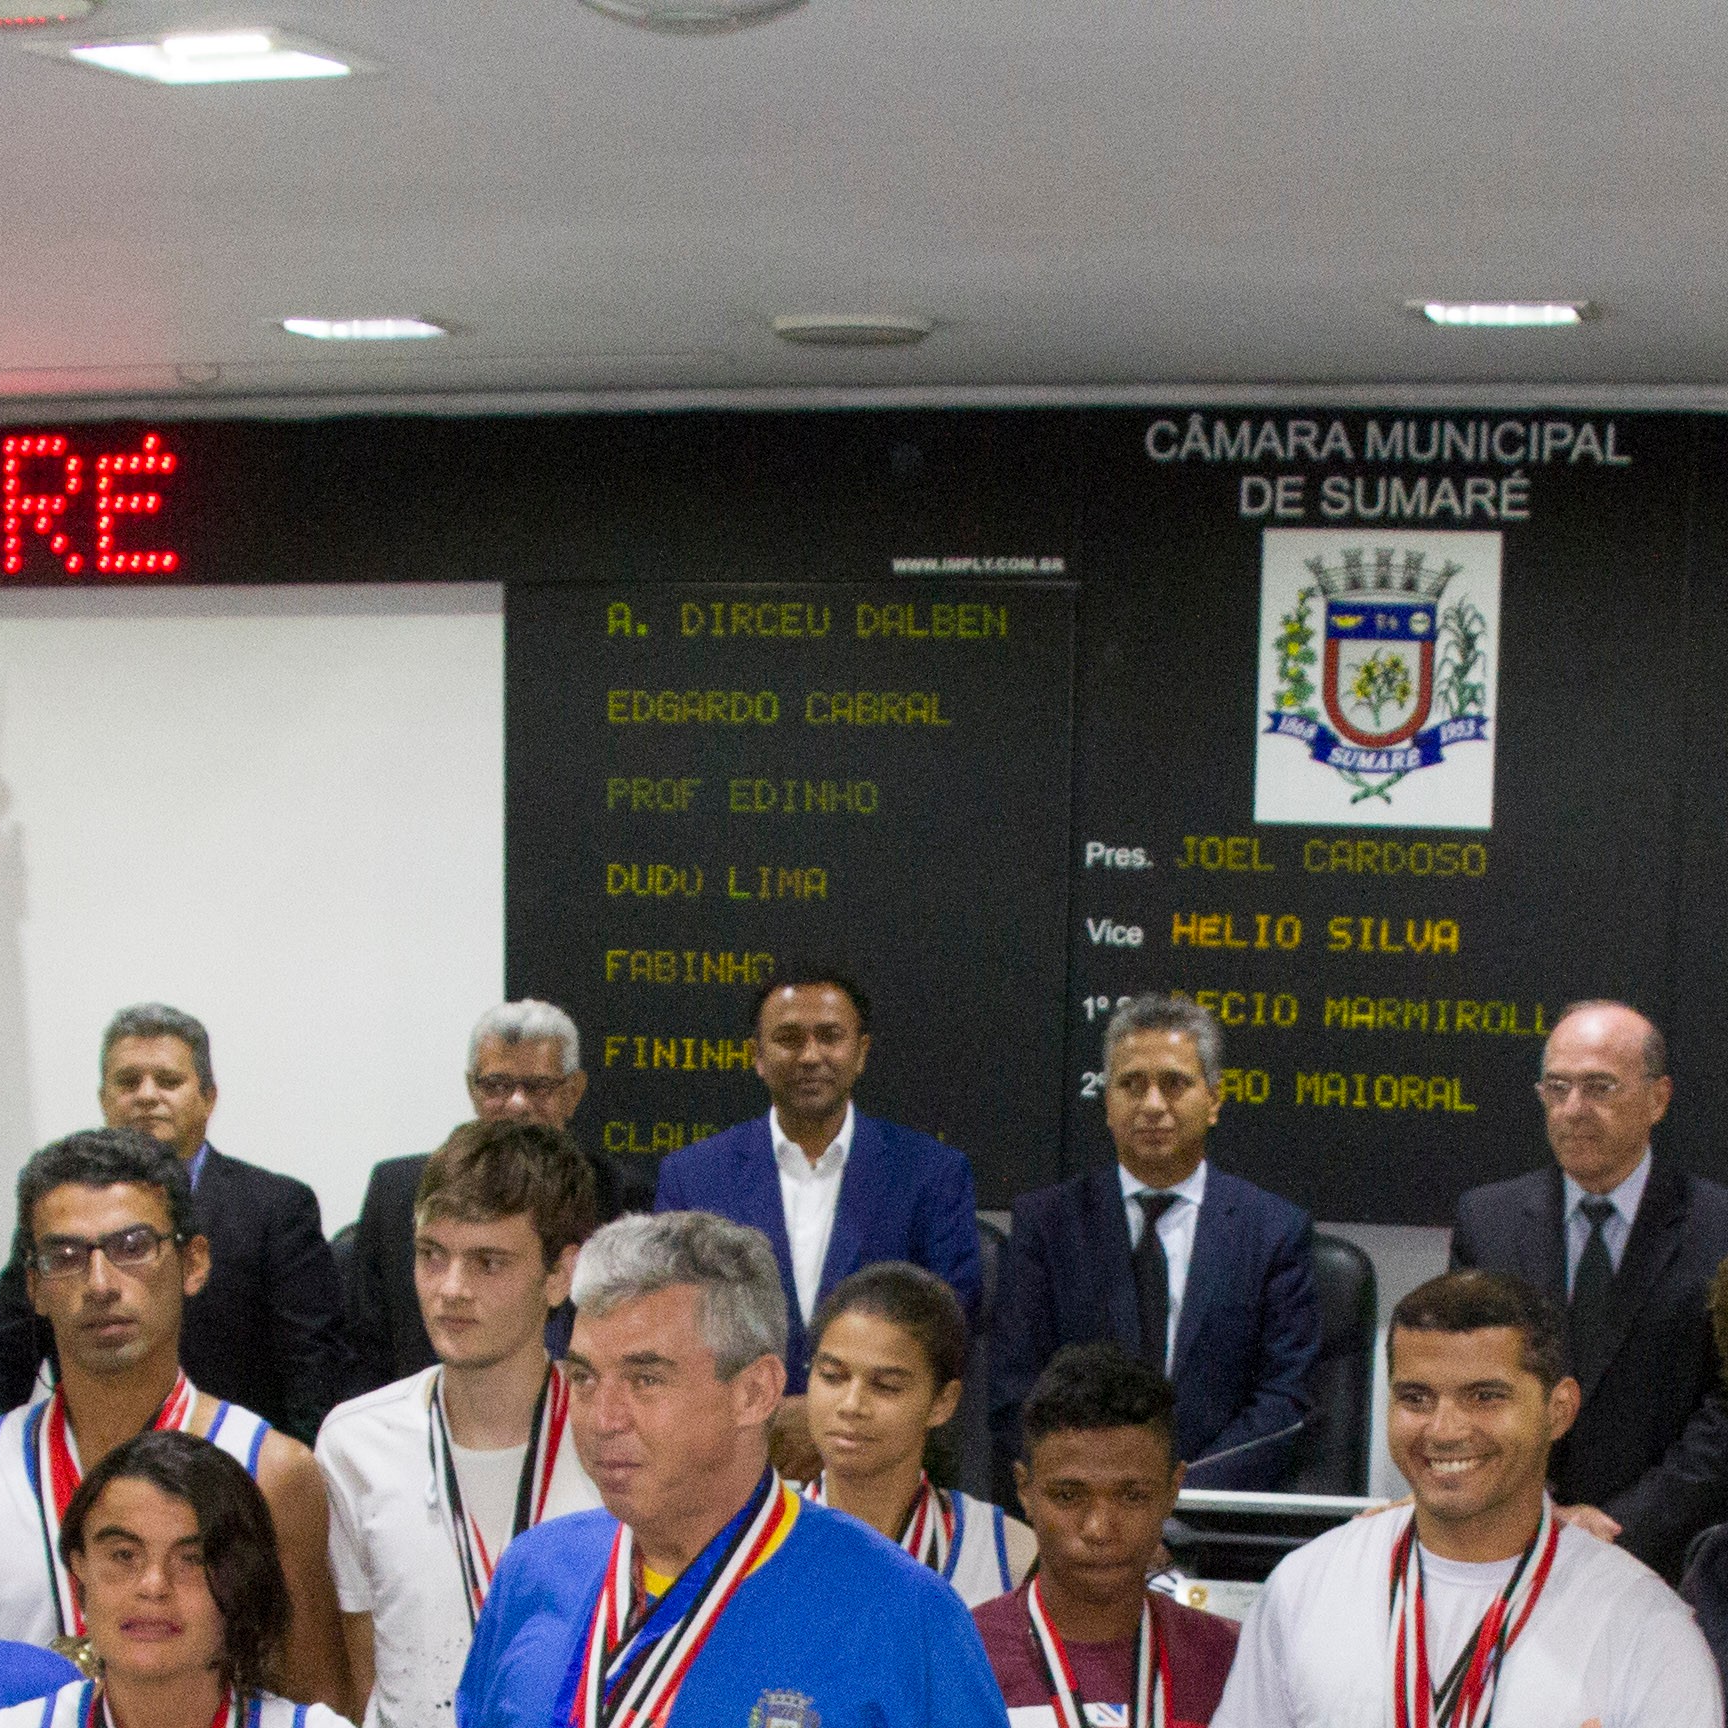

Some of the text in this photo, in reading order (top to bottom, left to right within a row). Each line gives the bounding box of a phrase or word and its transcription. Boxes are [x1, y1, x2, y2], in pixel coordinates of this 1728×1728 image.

[1145, 414, 1631, 464] CÂMARA MUNICIPAL
[1239, 470, 1530, 520] DE SUMARÉ
[607, 602, 1009, 639] A. DIRCEU DALBEN
[607, 690, 951, 726] EDGARDO CABRAL
[607, 778, 879, 814] PROF EDINHO
[1086, 836, 1487, 877] Pres. JOEL CARDOSO
[607, 863, 828, 900] DUDU LIMA
[1087, 917, 1143, 946] Vice
[1326, 916, 1460, 953] SILVA
[604, 1036, 757, 1071] FININH
[1295, 1072, 1477, 1112] MAIORAL
